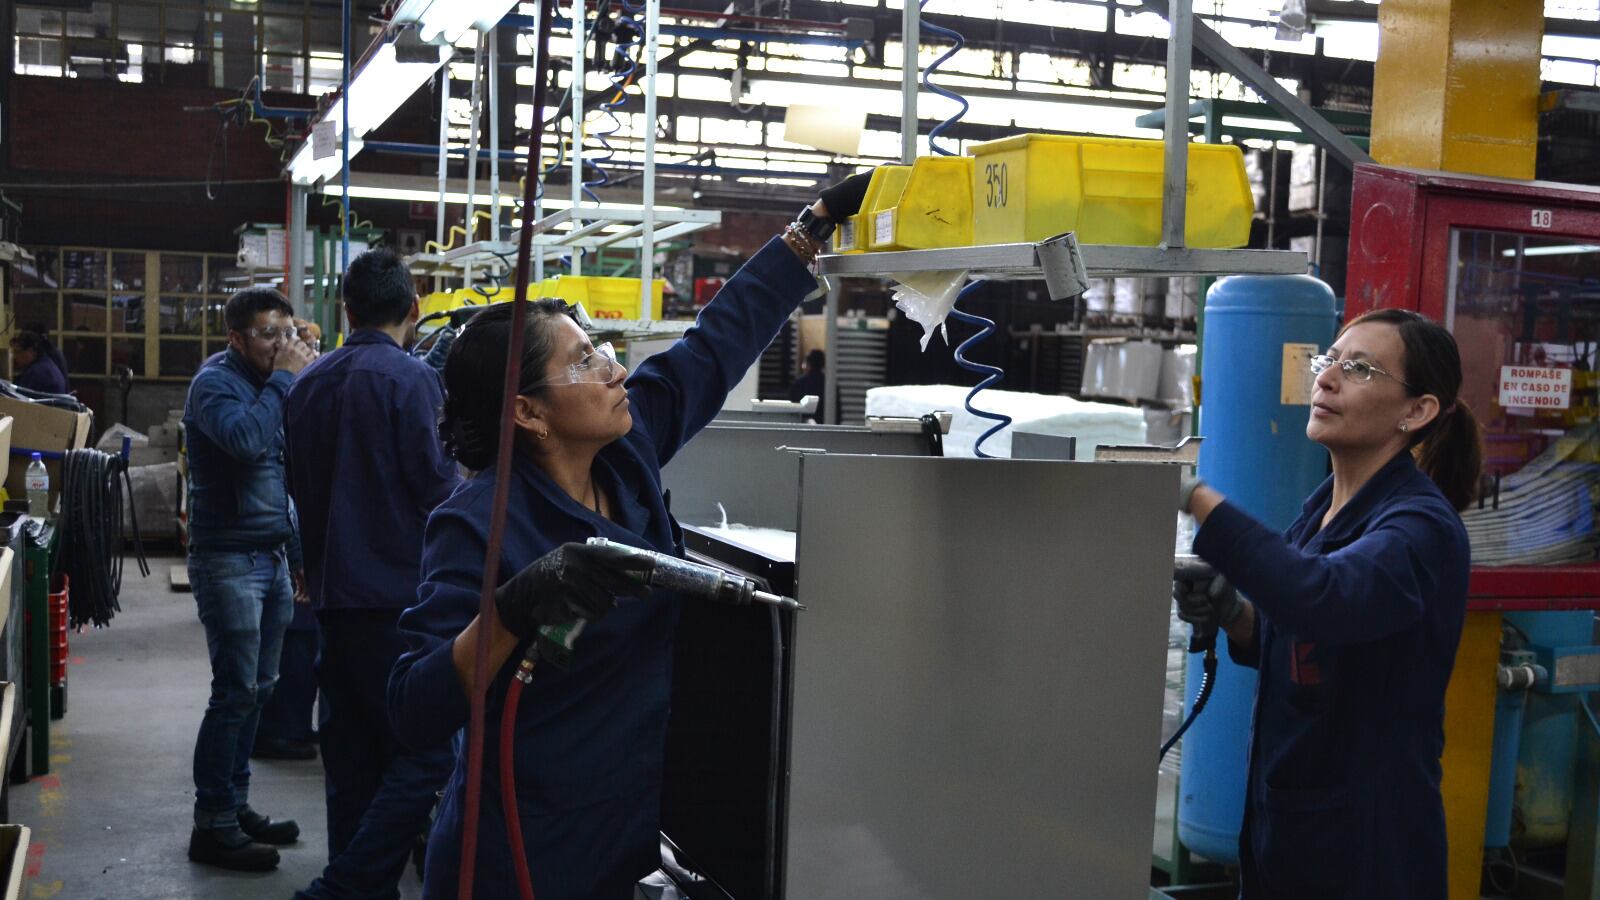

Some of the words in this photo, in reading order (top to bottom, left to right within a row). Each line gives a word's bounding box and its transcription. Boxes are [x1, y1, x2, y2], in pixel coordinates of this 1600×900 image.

[985, 161, 1008, 208] 350
[1533, 211, 1549, 226] 18
[1510, 368, 1562, 380] ROMPASE
[1503, 382, 1518, 391] EN
[1520, 383, 1550, 392] CASO
[1554, 384, 1568, 393] DE
[1508, 396, 1561, 406] INCENDIO
